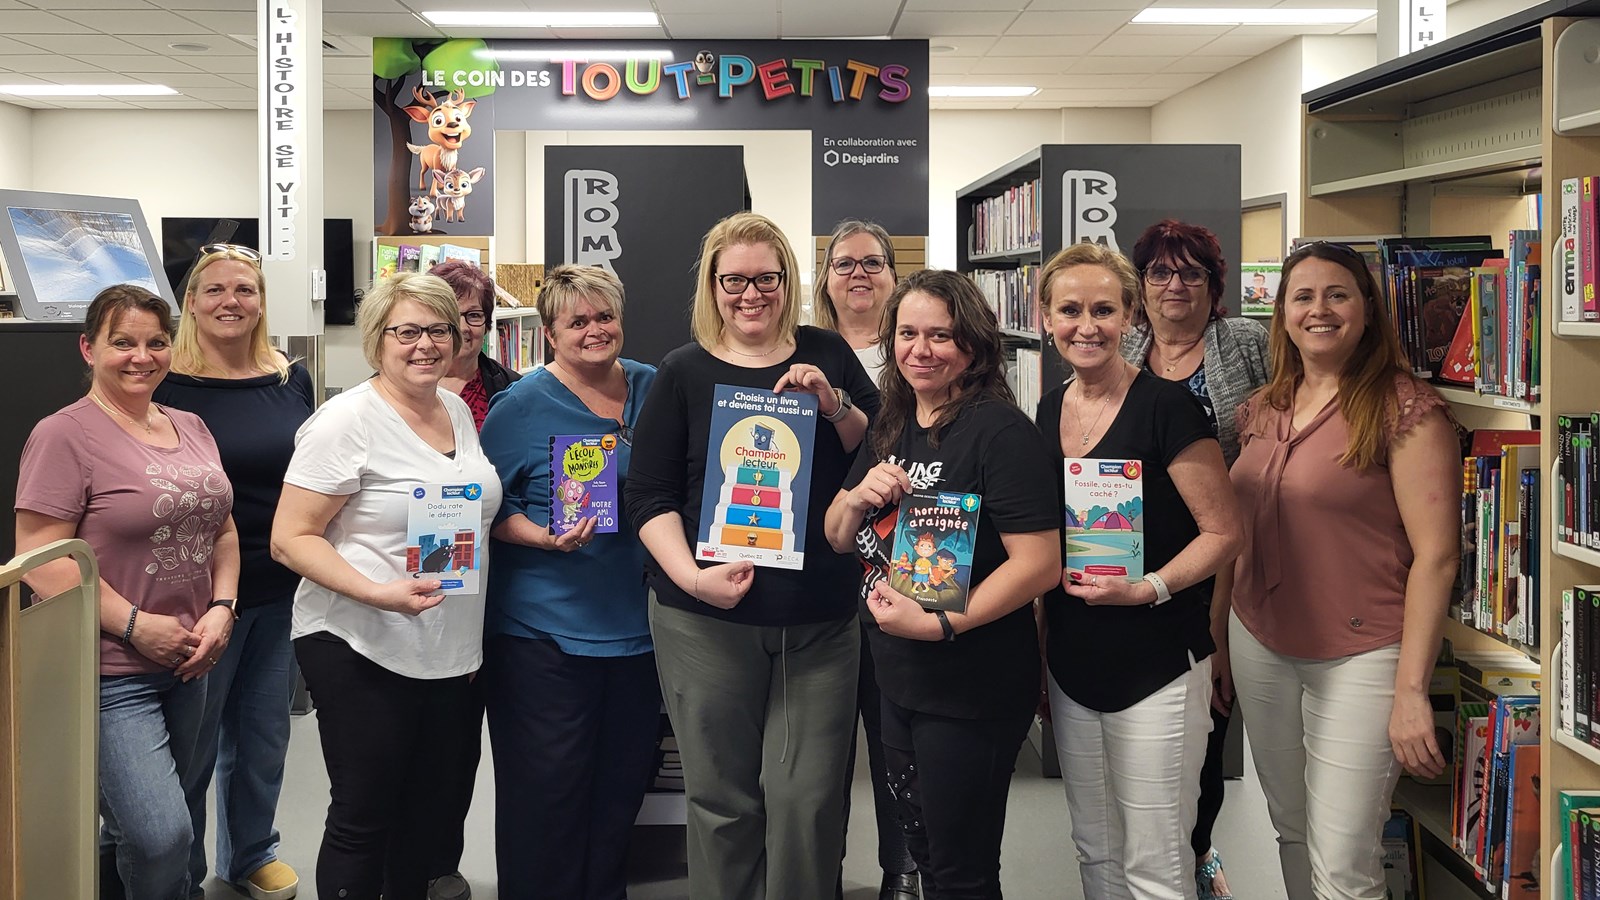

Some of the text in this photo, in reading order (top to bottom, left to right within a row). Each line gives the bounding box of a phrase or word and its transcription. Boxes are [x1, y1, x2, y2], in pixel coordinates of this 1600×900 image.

[274, 8, 295, 131] L'HISTOIRE
[421, 54, 911, 103] LE COIN DES TOUT-PETITS
[823, 138, 835, 146] En
[837, 137, 895, 146] collaboration
[276, 144, 294, 168] SE
[842, 153, 899, 166] Desjardins
[582, 178, 614, 269] ROM
[1565, 238, 1575, 295] emma
[734, 392, 765, 403] Choisis
[780, 397, 799, 406] livre
[729, 400, 762, 411] deviens
[764, 404, 775, 413] toi
[777, 406, 800, 415] aussi
[802, 408, 813, 416] un
[735, 446, 786, 460] Champion
[567, 460, 599, 475] MONSTRES
[742, 457, 778, 469] lecteur
[1074, 480, 1100, 488] Fossile,
[437, 511, 462, 519] départ
[595, 517, 614, 527] LIO
[909, 516, 969, 532] araignée
